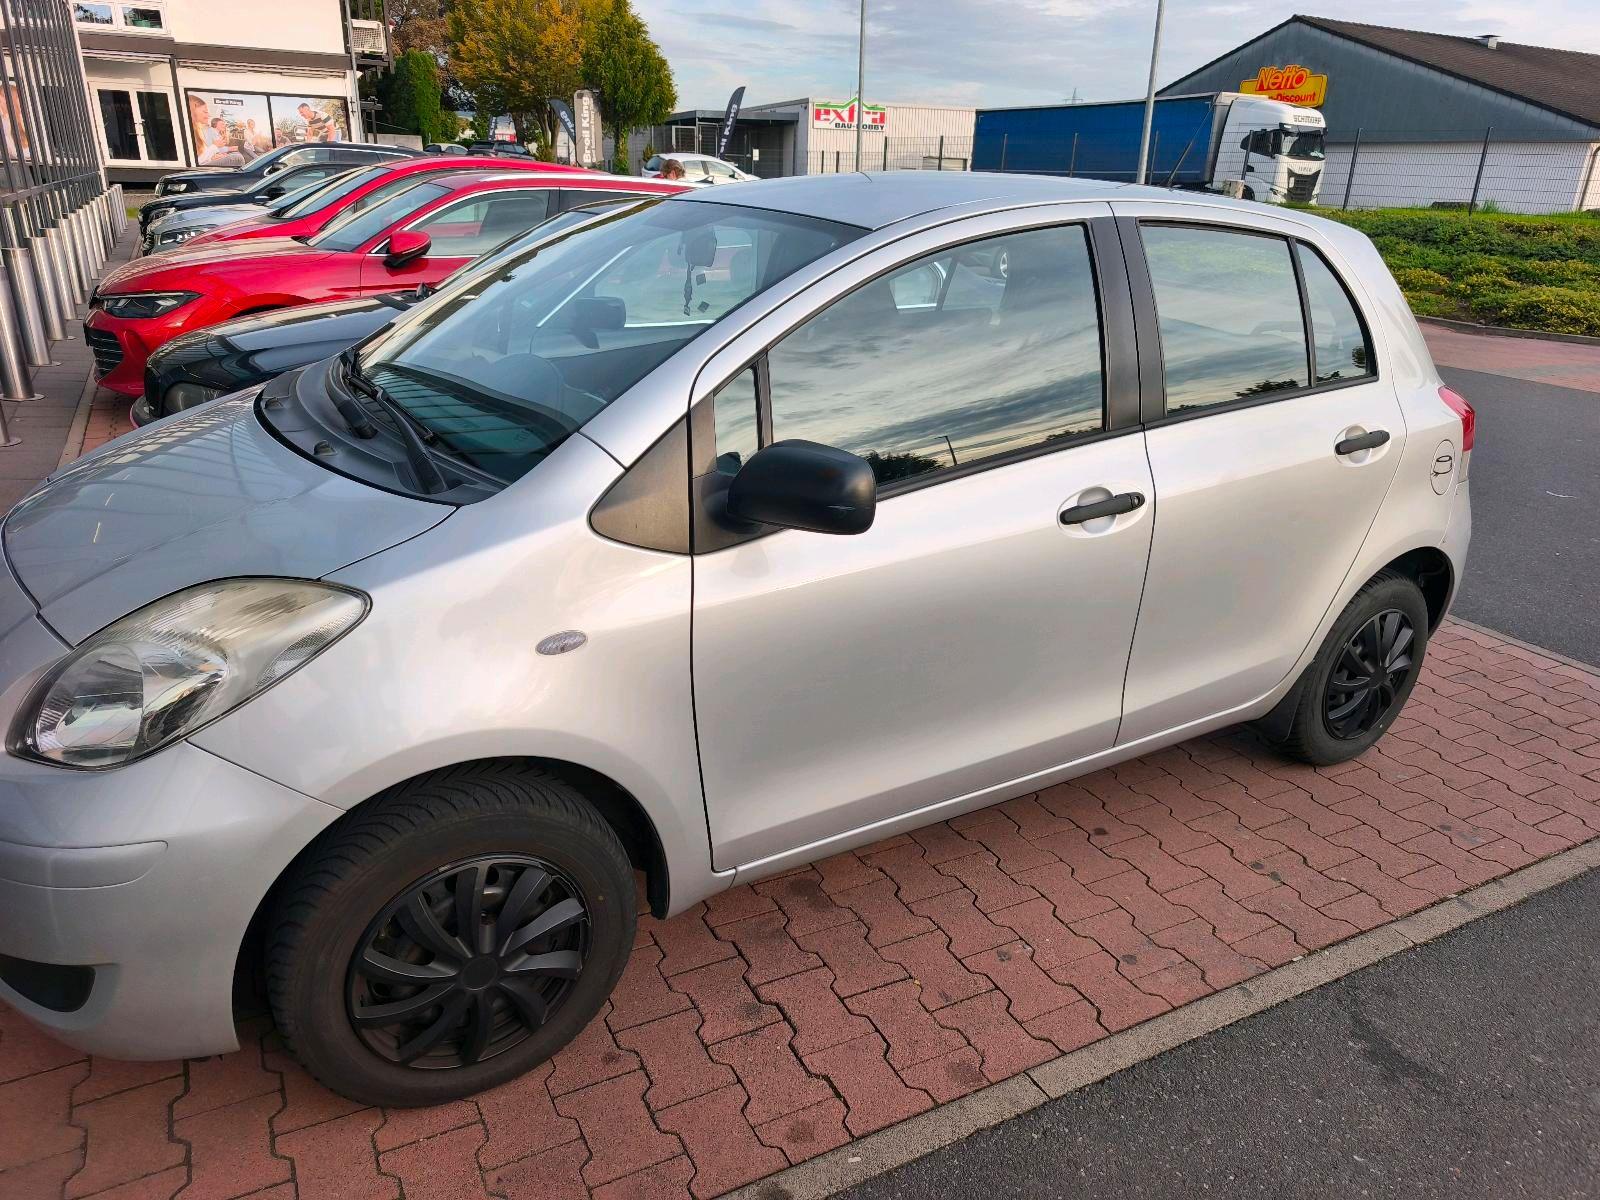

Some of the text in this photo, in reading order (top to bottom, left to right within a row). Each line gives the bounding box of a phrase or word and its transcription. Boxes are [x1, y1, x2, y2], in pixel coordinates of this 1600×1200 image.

[1256, 66, 1308, 91] Netto
[1268, 91, 1316, 103] -Discount
[581, 97, 591, 163] Broil King
[835, 123, 884, 131] BAU-OBBY
